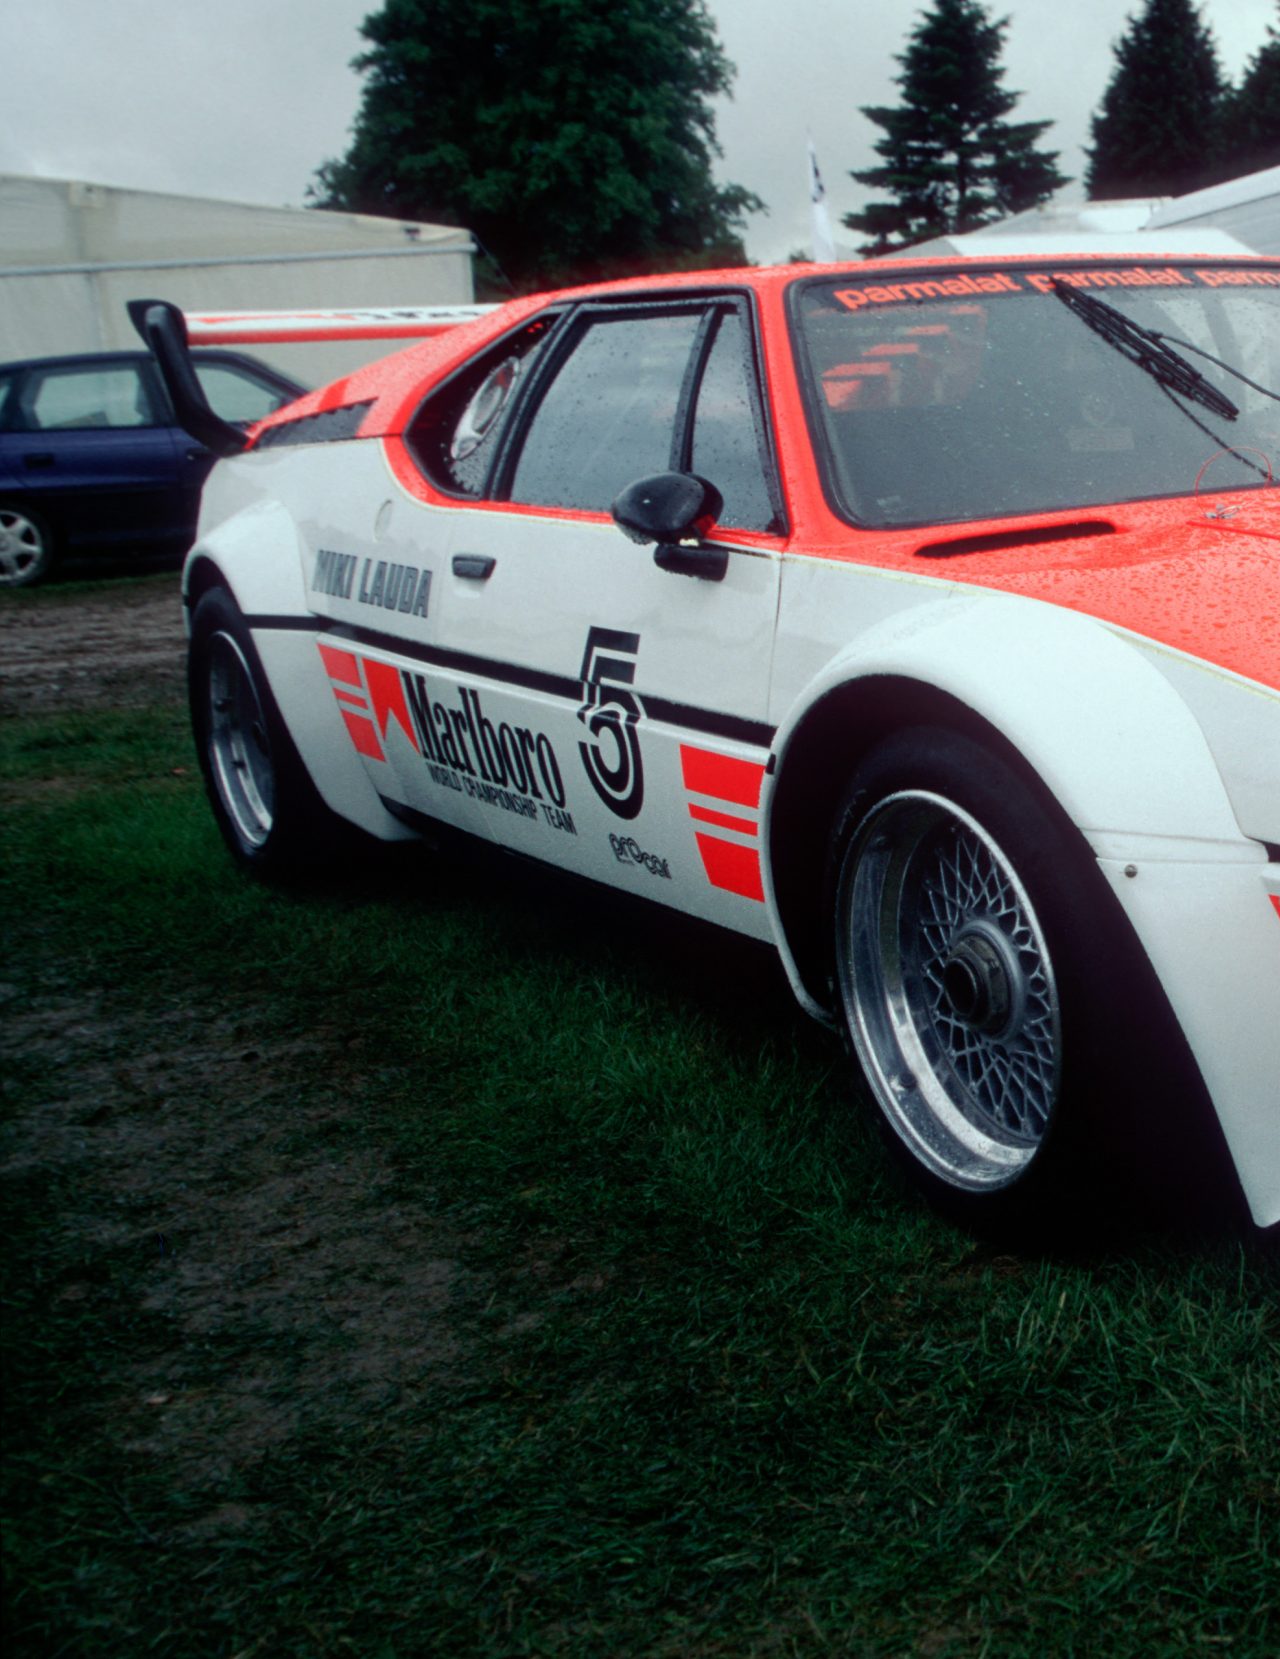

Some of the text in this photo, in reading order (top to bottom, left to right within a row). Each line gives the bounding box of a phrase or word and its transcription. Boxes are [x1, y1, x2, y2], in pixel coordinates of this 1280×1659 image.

[834, 273, 1021, 310] parmalat
[312, 549, 433, 618] NIKI LAUDA
[401, 671, 566, 809] Marlboro
[576, 625, 645, 821] 5
[426, 762, 578, 836] WORLD CHAMPIONSHIP TEAM
